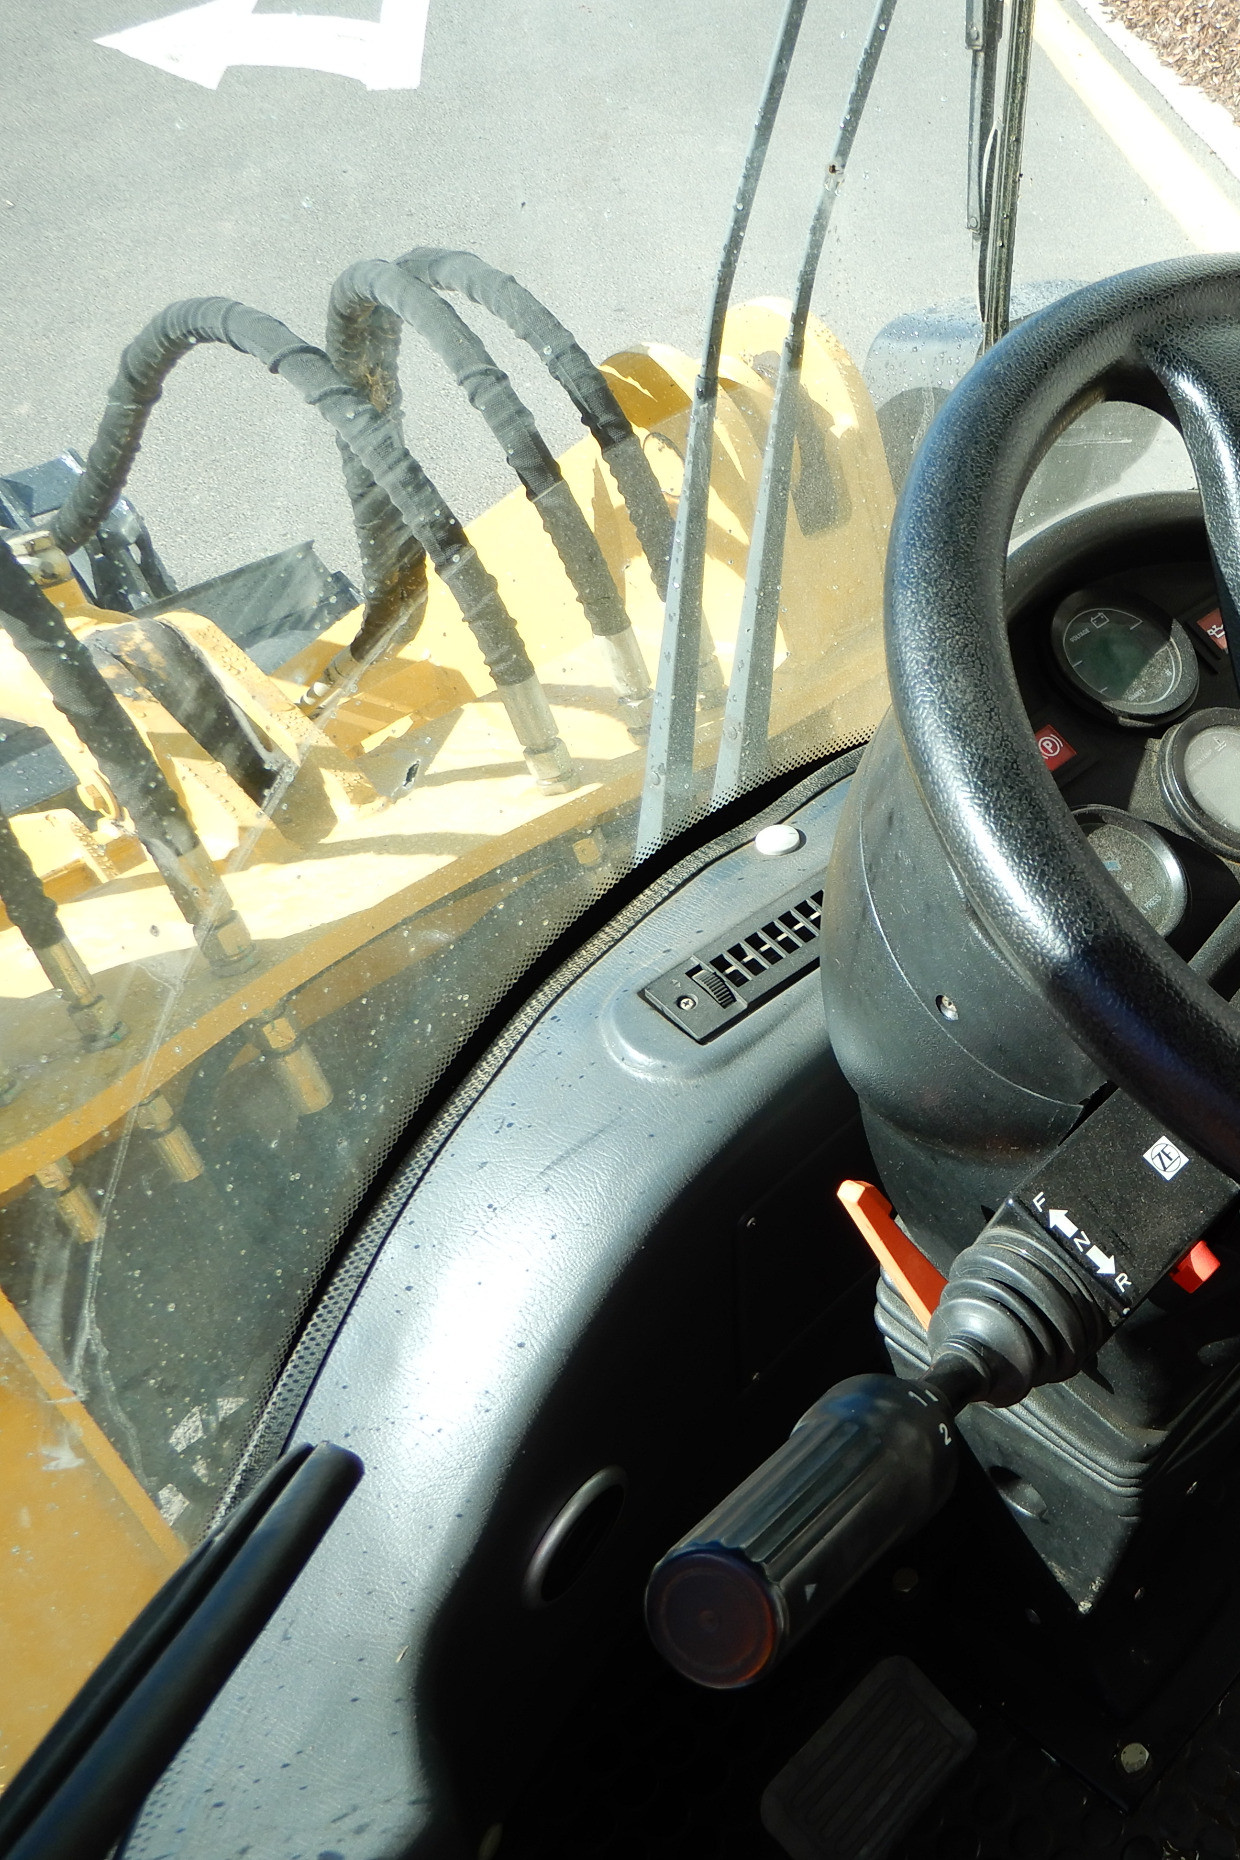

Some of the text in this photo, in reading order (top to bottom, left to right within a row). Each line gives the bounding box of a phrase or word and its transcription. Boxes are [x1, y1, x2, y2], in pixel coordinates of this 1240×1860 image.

[1042, 740, 1054, 754] P
[1143, 892, 1162, 911] PRESS
[1151, 1143, 1181, 1172] ZF
[1032, 1191, 1046, 1213] F
[1073, 1230, 1091, 1253] N
[1114, 1272, 1132, 1293] R
[939, 1422, 952, 1446] 2
